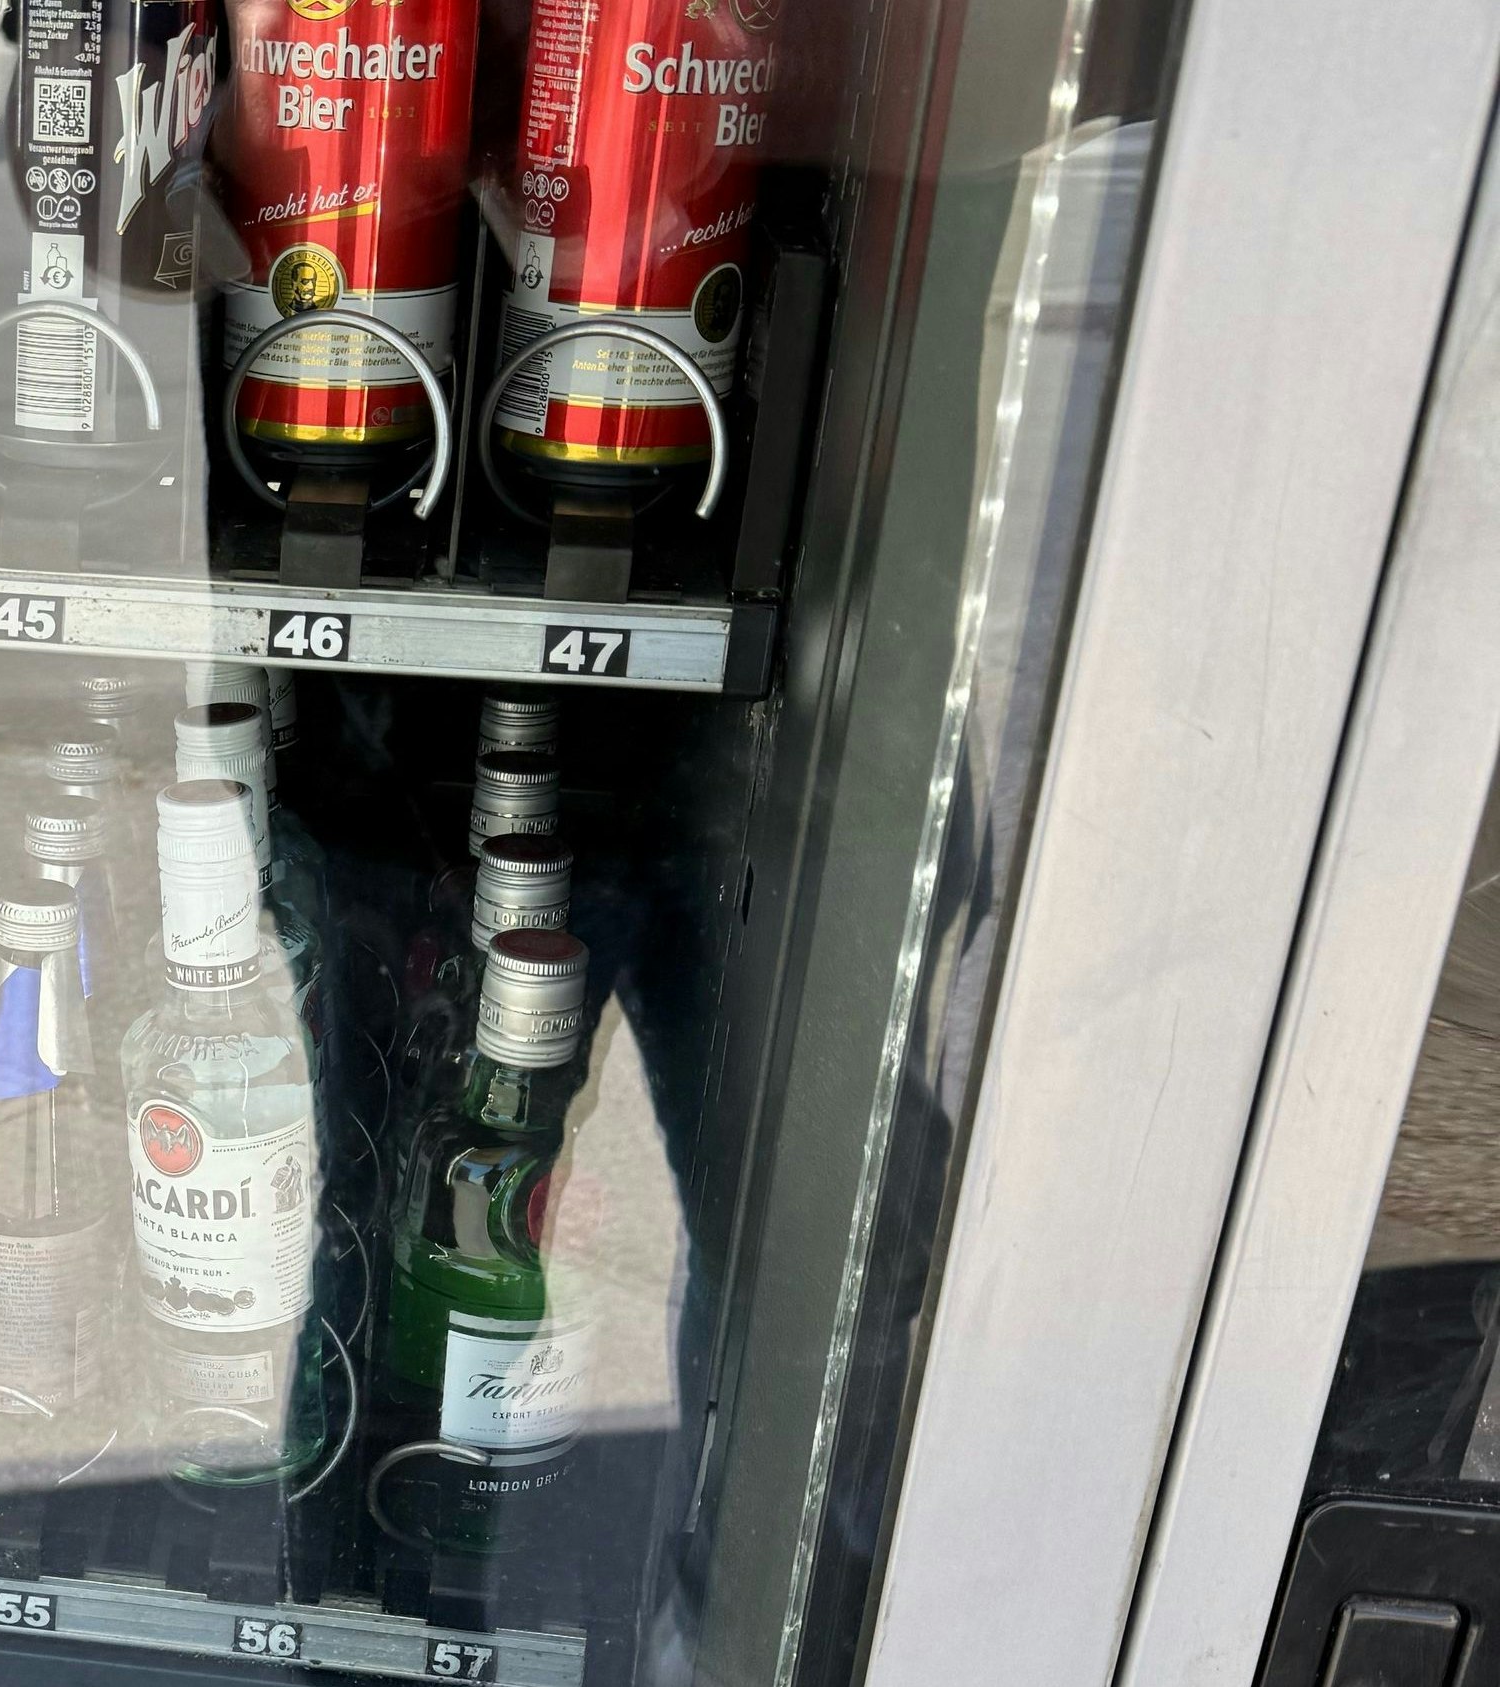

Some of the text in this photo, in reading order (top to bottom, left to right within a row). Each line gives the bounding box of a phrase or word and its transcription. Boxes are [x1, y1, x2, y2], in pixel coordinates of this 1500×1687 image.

[240, 26, 444, 80] chwechater
[276, 84, 354, 130] Bier
[715, 102, 768, 147] Bier
[310, 184, 348, 214] hat
[82, 368, 92, 412] 028800
[273, 615, 344, 659] 46
[549, 630, 624, 674] 47
[493, 909, 549, 928] LONDON
[176, 966, 243, 984] WHITE RUM
[132, 1173, 251, 1221] ACARDÍ
[135, 1213, 238, 1243] ARTA BLANCA
[172, 1264, 222, 1277] WHITE RUM
[228, 1369, 260, 1379] CUBA
[492, 1411, 531, 1420] EXPORT
[468, 1471, 560, 1493] LONDON DRY
[238, 1624, 297, 1656] 56
[434, 1644, 494, 1676] 57
